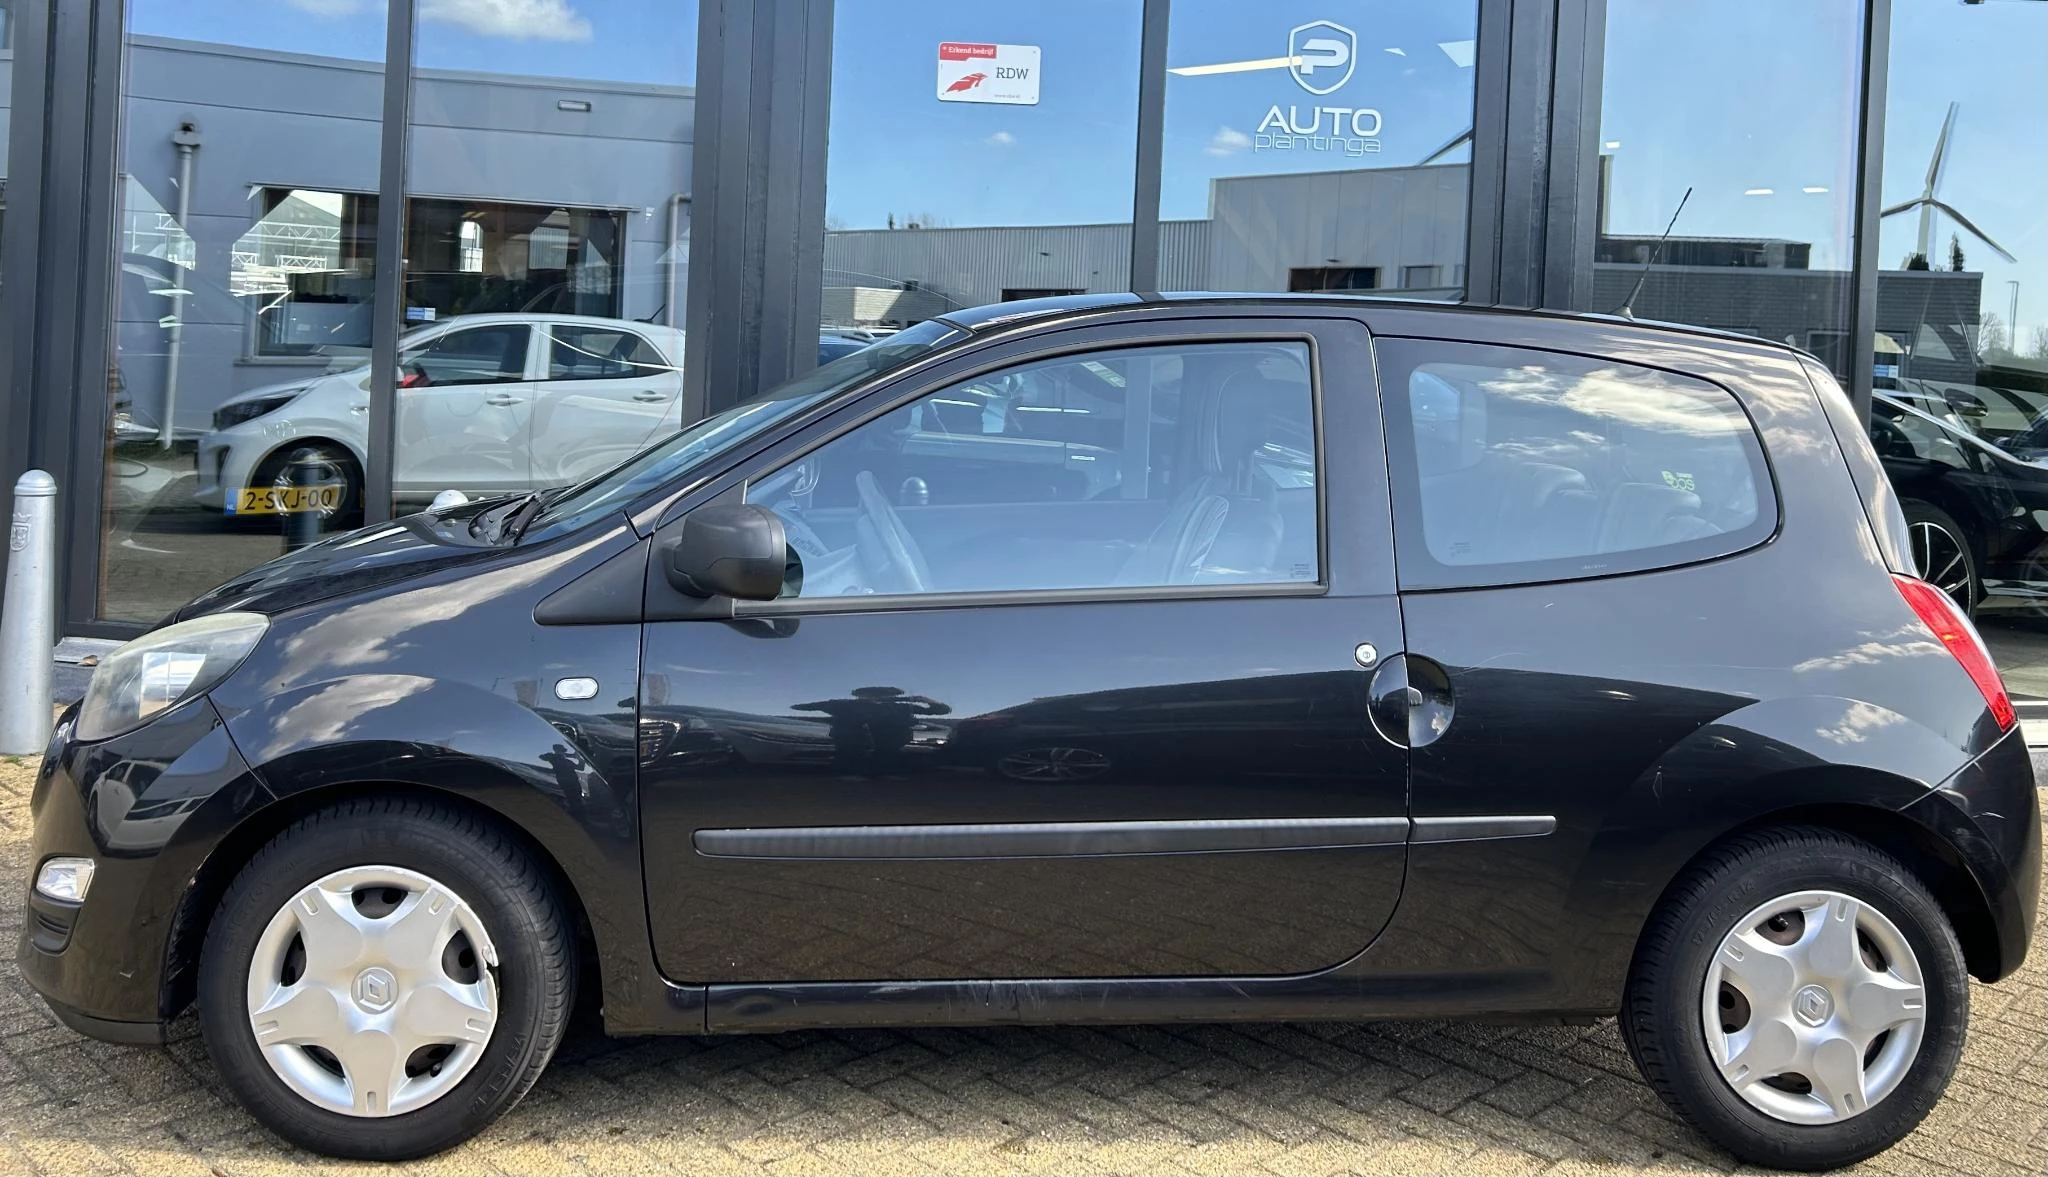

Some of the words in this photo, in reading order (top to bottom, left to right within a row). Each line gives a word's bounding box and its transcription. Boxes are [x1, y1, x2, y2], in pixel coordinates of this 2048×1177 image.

[948, 46, 972, 54] Erkend
[972, 47, 994, 56] bedrijf
[996, 67, 1029, 80] RDW
[1256, 105, 1382, 136] AUTO
[1254, 132, 1381, 156] plantinga
[244, 489, 333, 510] 2-SKJ-00
